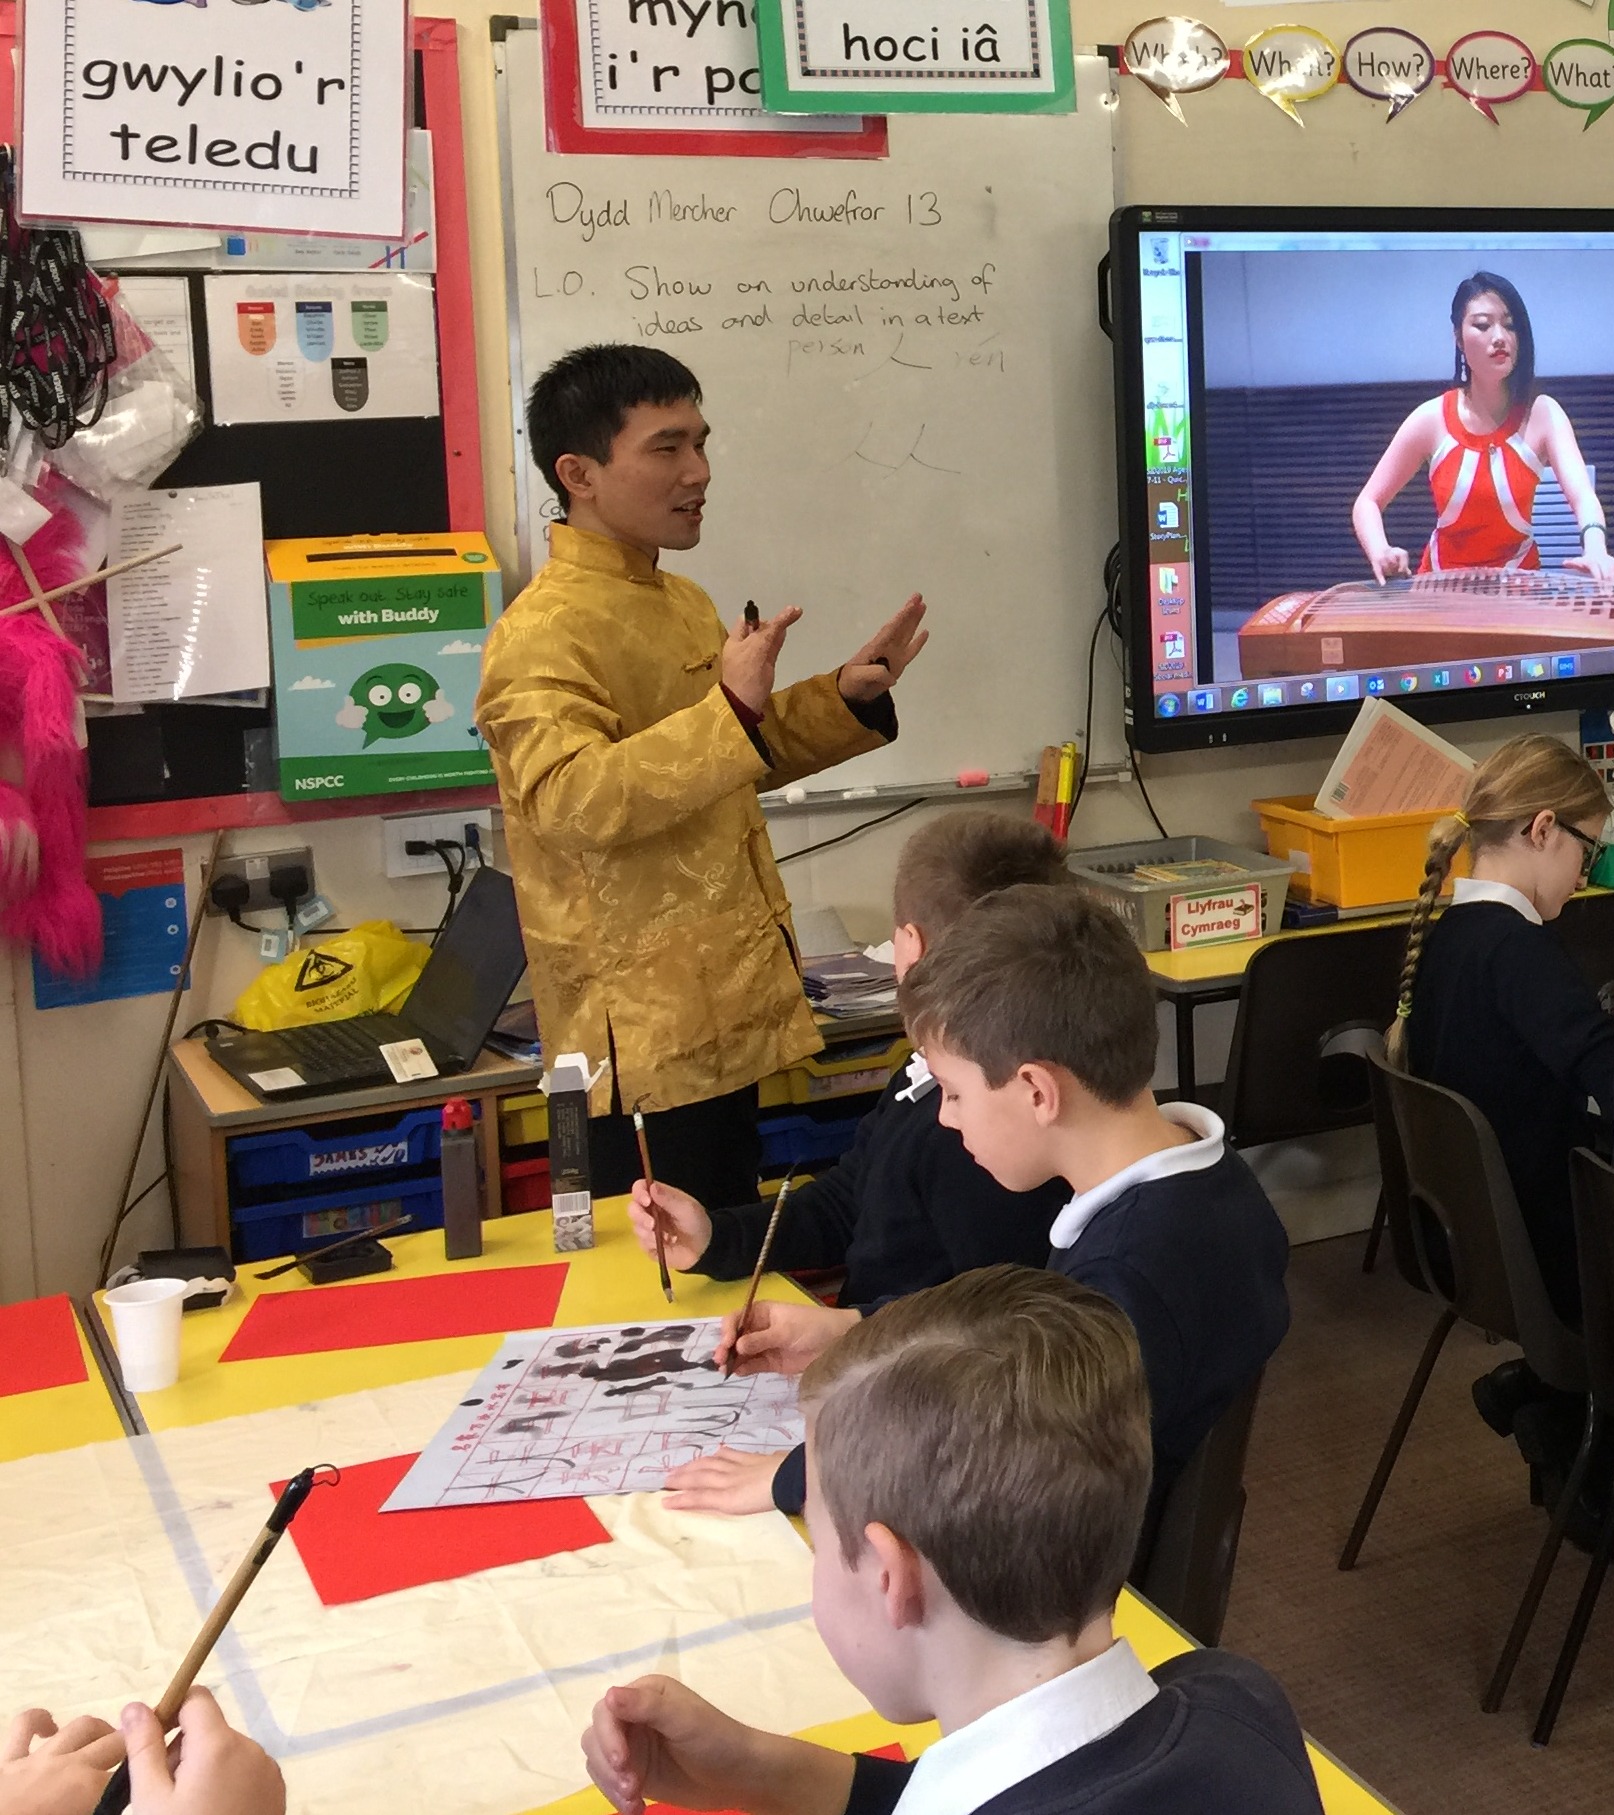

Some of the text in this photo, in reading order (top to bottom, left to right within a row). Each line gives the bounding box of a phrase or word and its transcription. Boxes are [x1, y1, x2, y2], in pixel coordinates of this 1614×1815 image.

[628, 0, 757, 37] myn
[842, 23, 1000, 63] hoci iâ
[1131, 41, 1223, 67] Whch?
[607, 52, 678, 92] i'r
[1358, 52, 1424, 77] How?
[1451, 57, 1531, 81] Where?
[81, 54, 345, 106] gwylio'r
[111, 123, 318, 175] teledu
[546, 181, 943, 241] Dydd Mercher Chwefror 13
[534, 263, 995, 301] L.O. Show an understanding of
[637, 304, 984, 337] ideas and detail in a text
[52, 372, 65, 404] STUDENT
[308, 585, 468, 610] Speak Stay safe
[338, 607, 439, 625] with Buddy
[1514, 690, 1546, 701] CTOUCH
[295, 775, 344, 790] NSPCC
[1187, 898, 1234, 916] Llyfrau
[1181, 917, 1241, 936] Cymraeg
